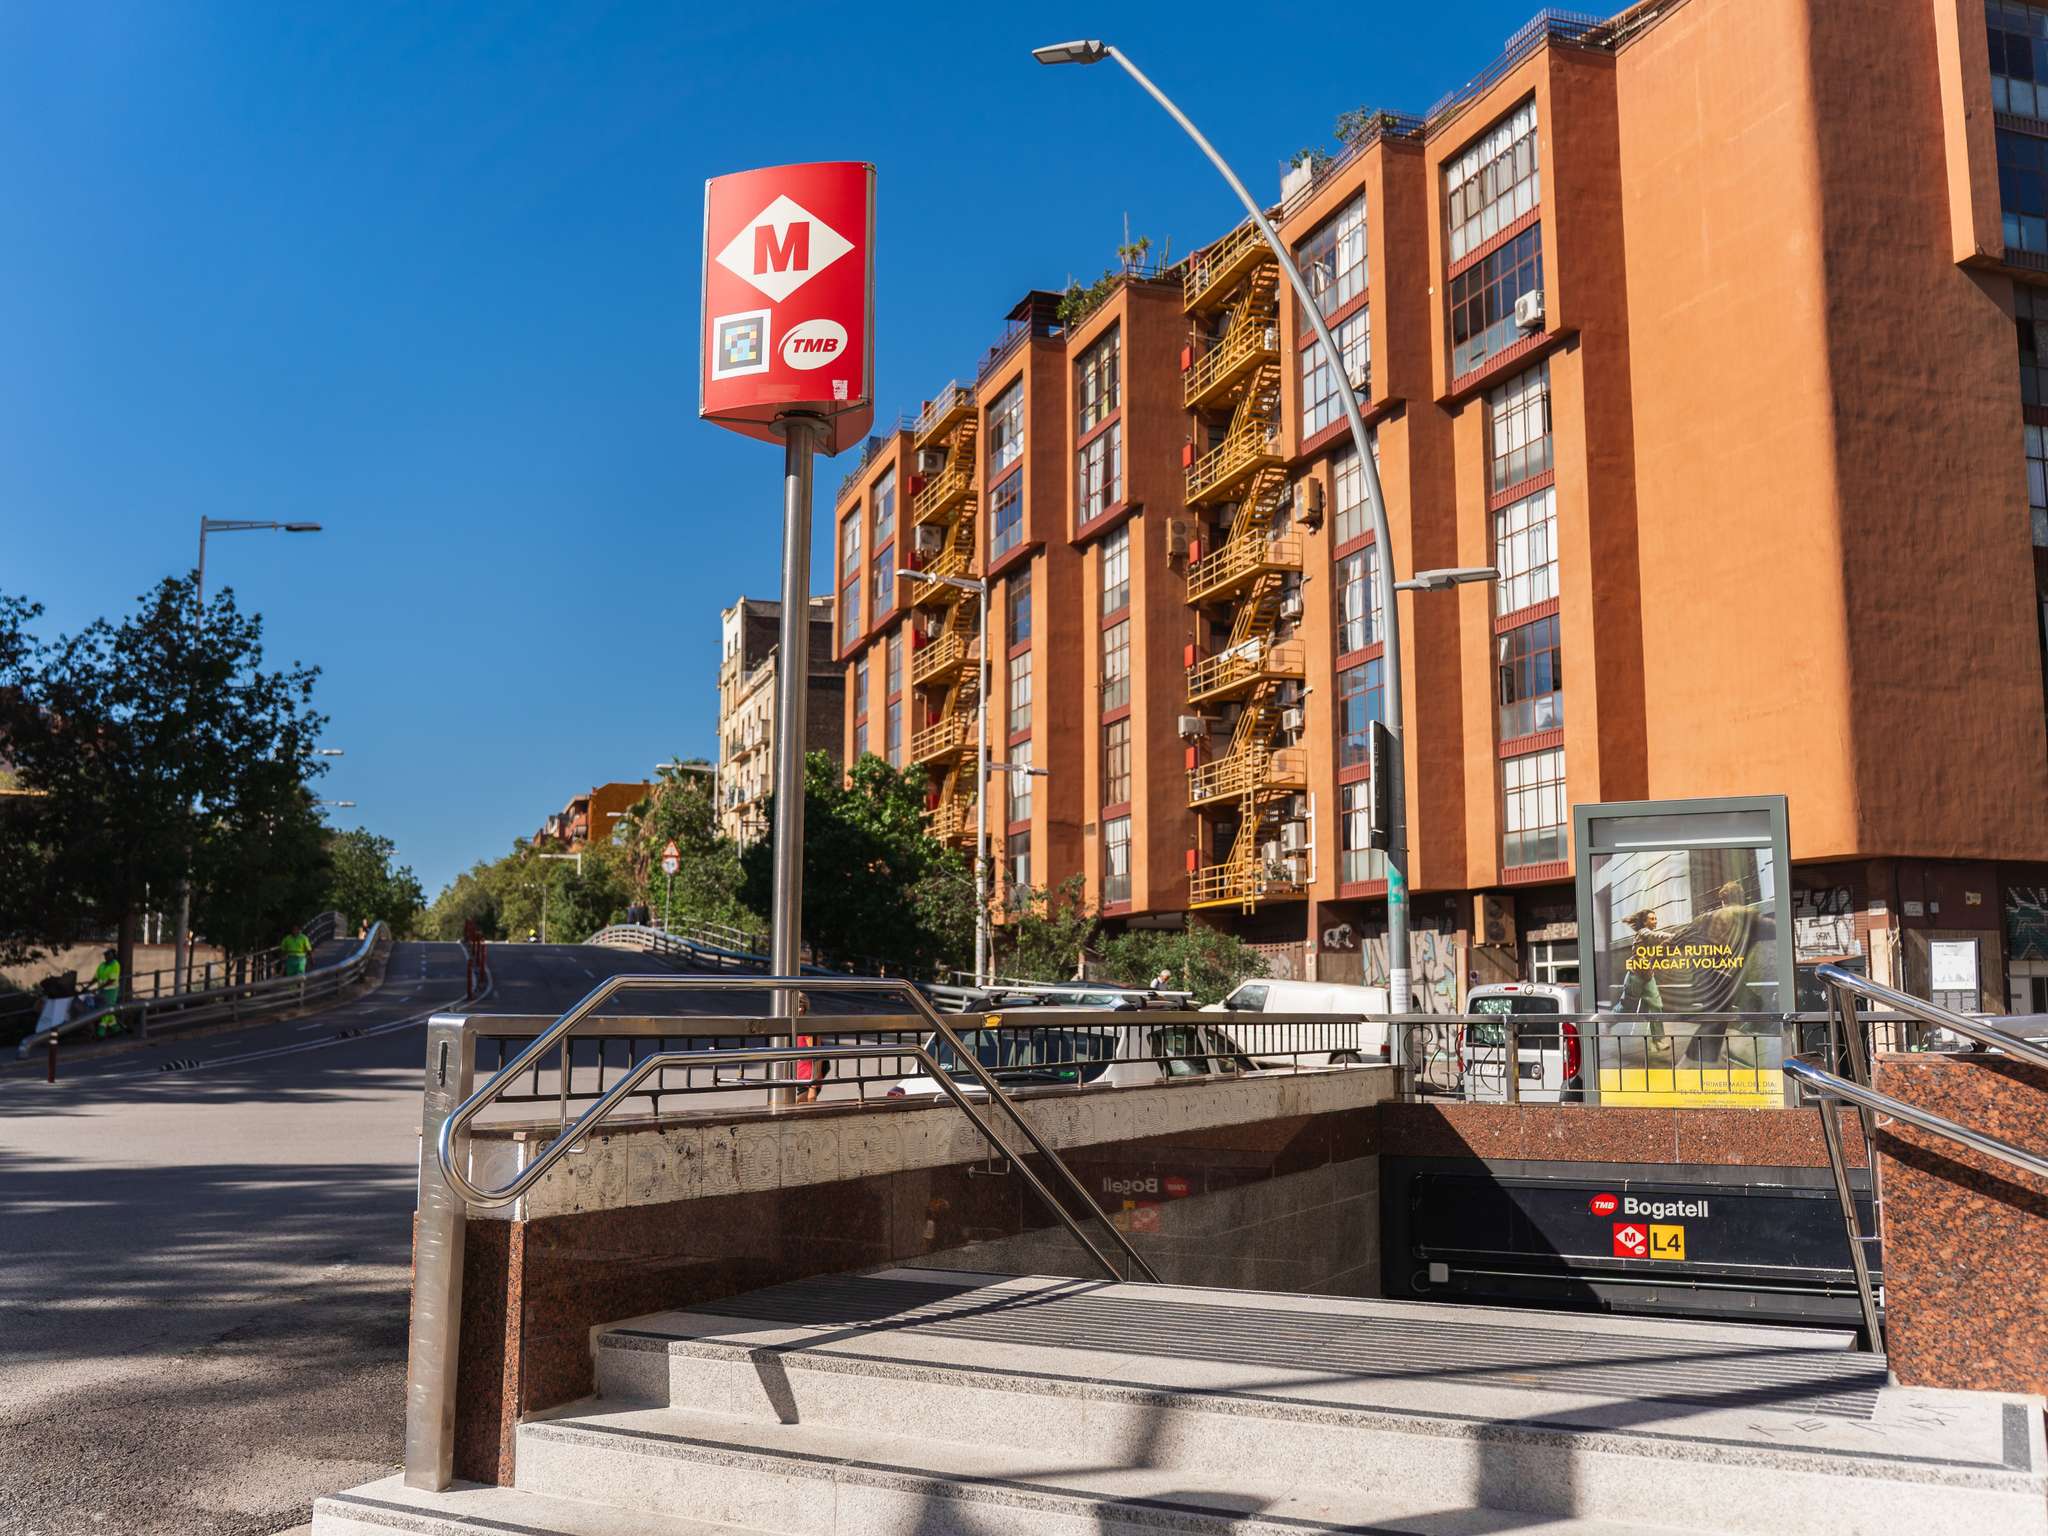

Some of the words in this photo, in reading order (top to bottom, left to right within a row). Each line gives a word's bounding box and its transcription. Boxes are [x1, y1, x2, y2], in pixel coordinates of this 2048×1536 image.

[754, 221, 810, 275] M
[793, 338, 838, 353] TMB
[1636, 945, 1663, 959] QUE
[1666, 945, 1681, 957] LA
[1684, 944, 1732, 957] RUTINA
[1626, 959, 1650, 970] ENS
[1652, 958, 1690, 970] AGAFI
[1693, 956, 1744, 969] VOLANT
[1594, 1201, 1615, 1210] TMB
[1624, 1197, 1709, 1220] Bogatell
[1624, 1232, 1636, 1243] M
[1653, 1232, 1681, 1252] L4
